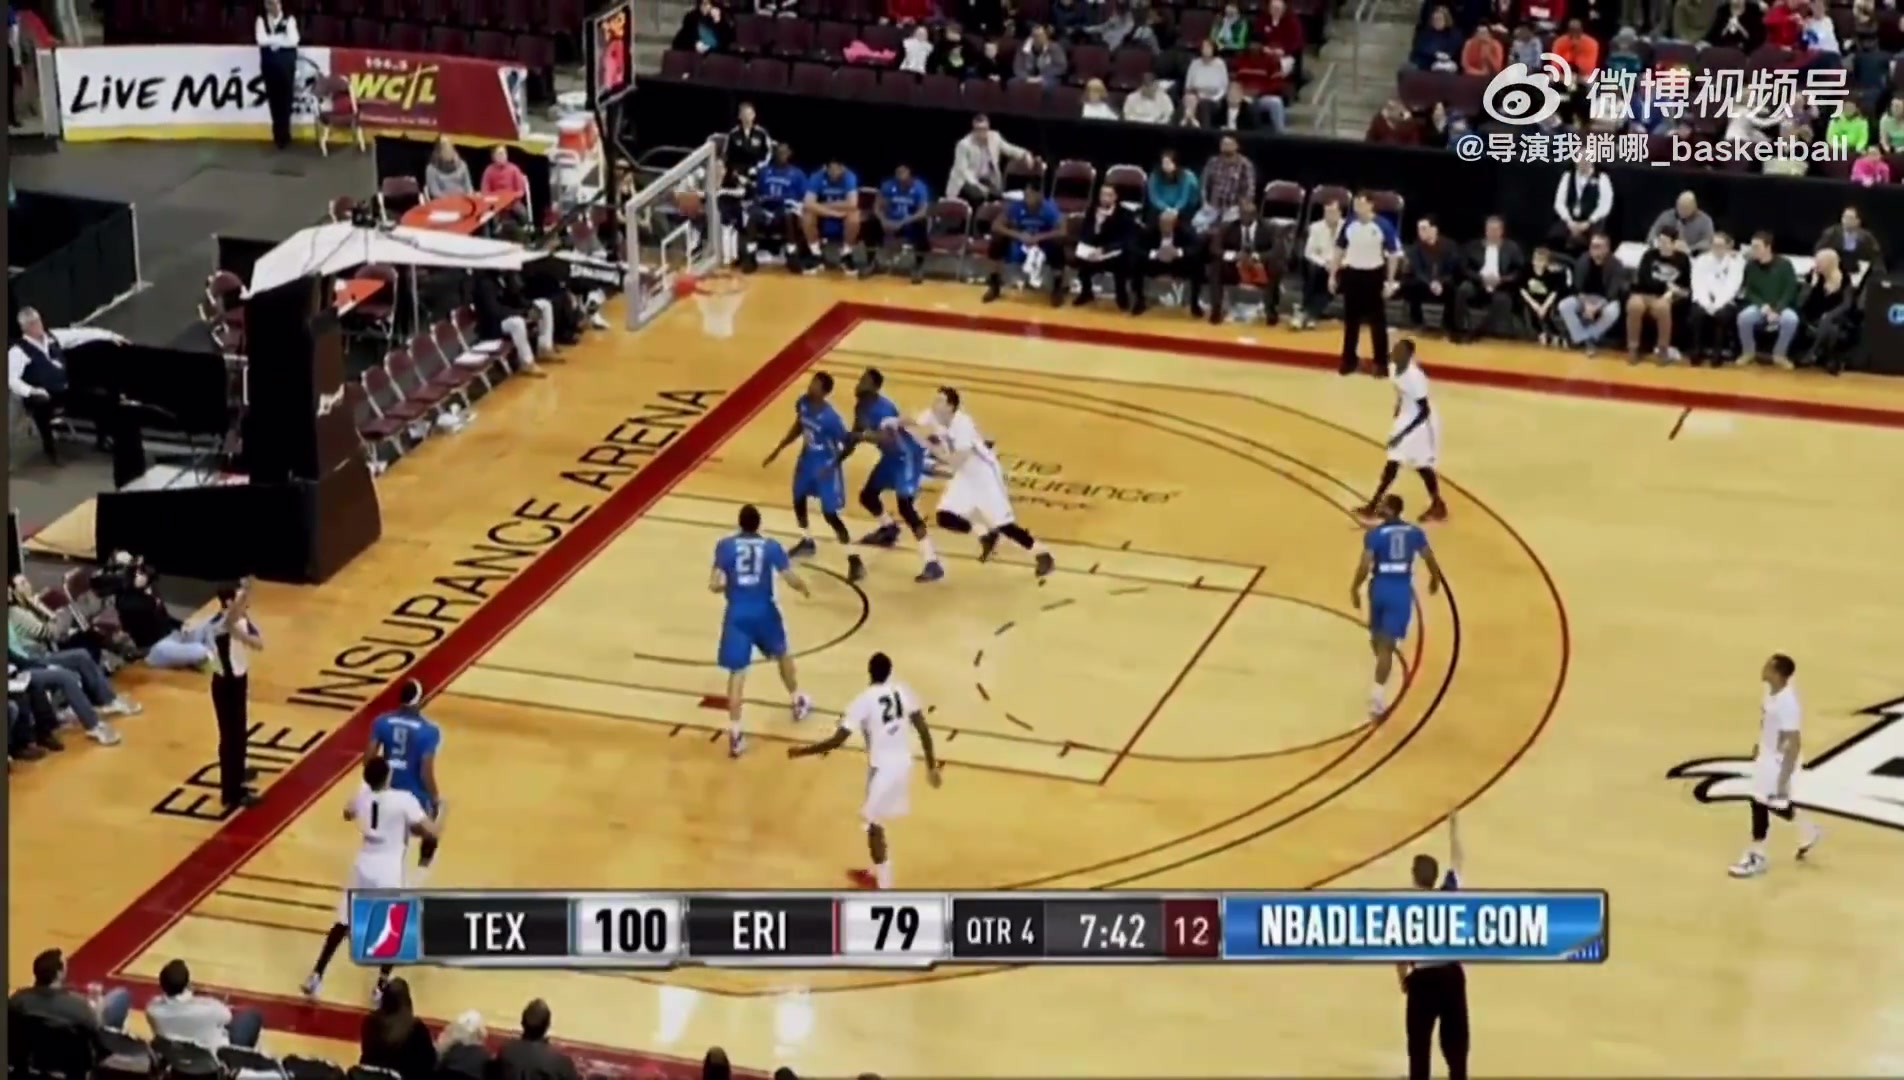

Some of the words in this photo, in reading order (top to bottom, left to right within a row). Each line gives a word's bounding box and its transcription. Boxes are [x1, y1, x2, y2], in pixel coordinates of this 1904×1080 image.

[171, 66, 269, 113] MÁS
[287, 497, 592, 712] INSURANCE
[559, 388, 727, 492] ARENA
[735, 544, 764, 574] 21
[878, 690, 904, 725] 21
[370, 799, 379, 830] 1
